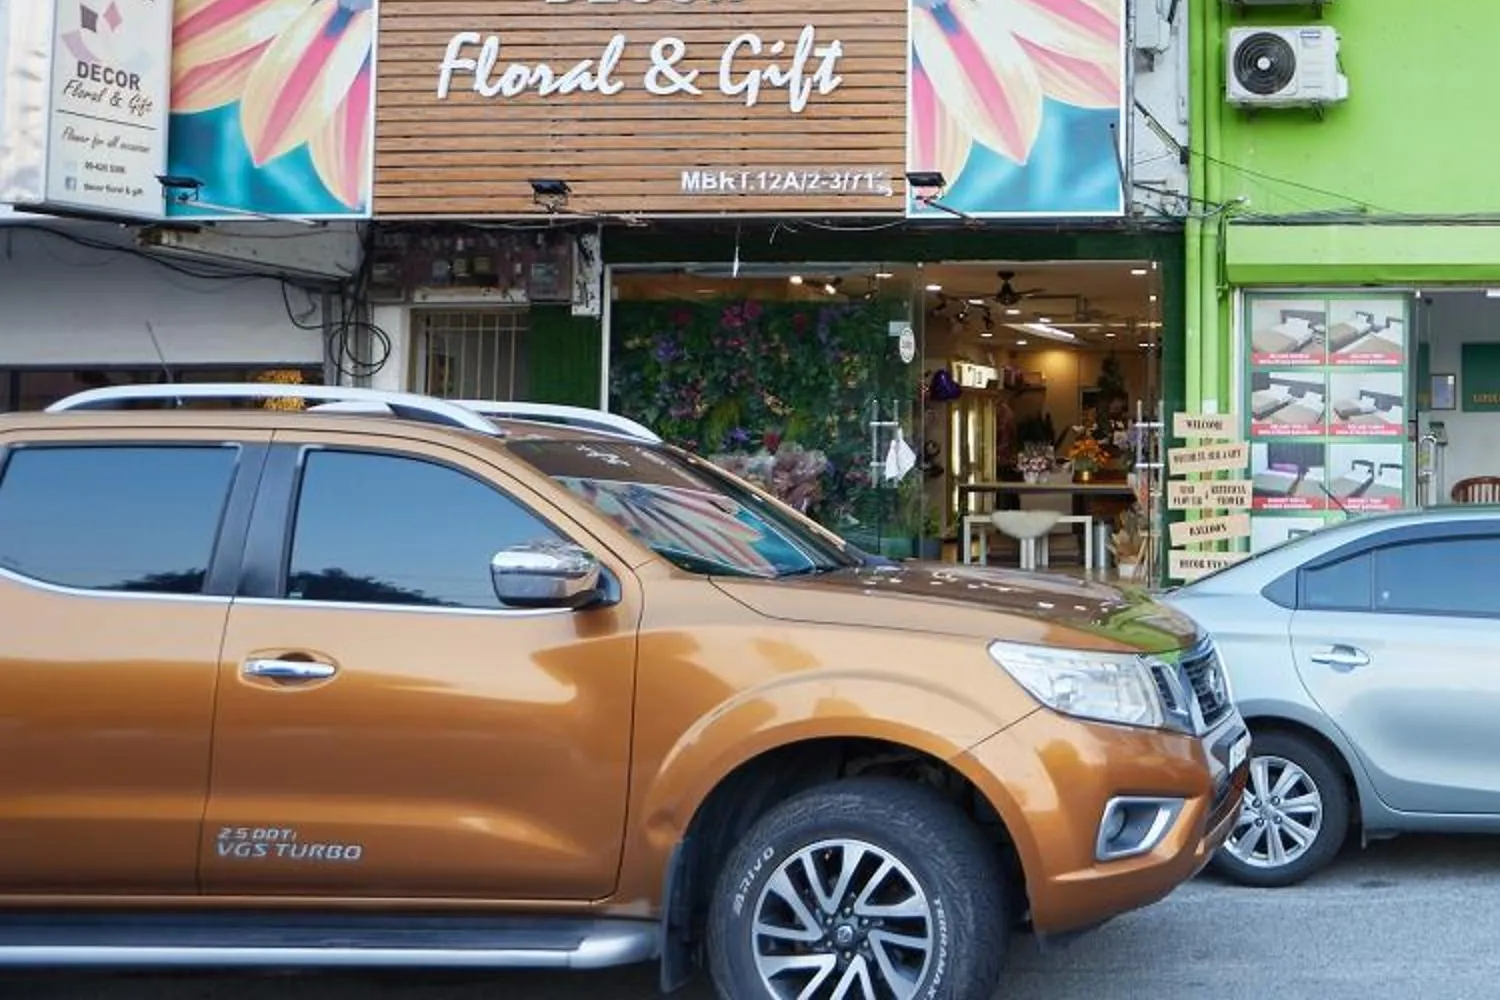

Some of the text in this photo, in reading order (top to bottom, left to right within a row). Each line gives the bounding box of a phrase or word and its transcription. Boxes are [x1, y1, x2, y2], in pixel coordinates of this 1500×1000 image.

[77, 61, 141, 91] DECOR
[437, 24, 844, 114] Floral & Gift
[217, 842, 362, 860] VGS TURBO
